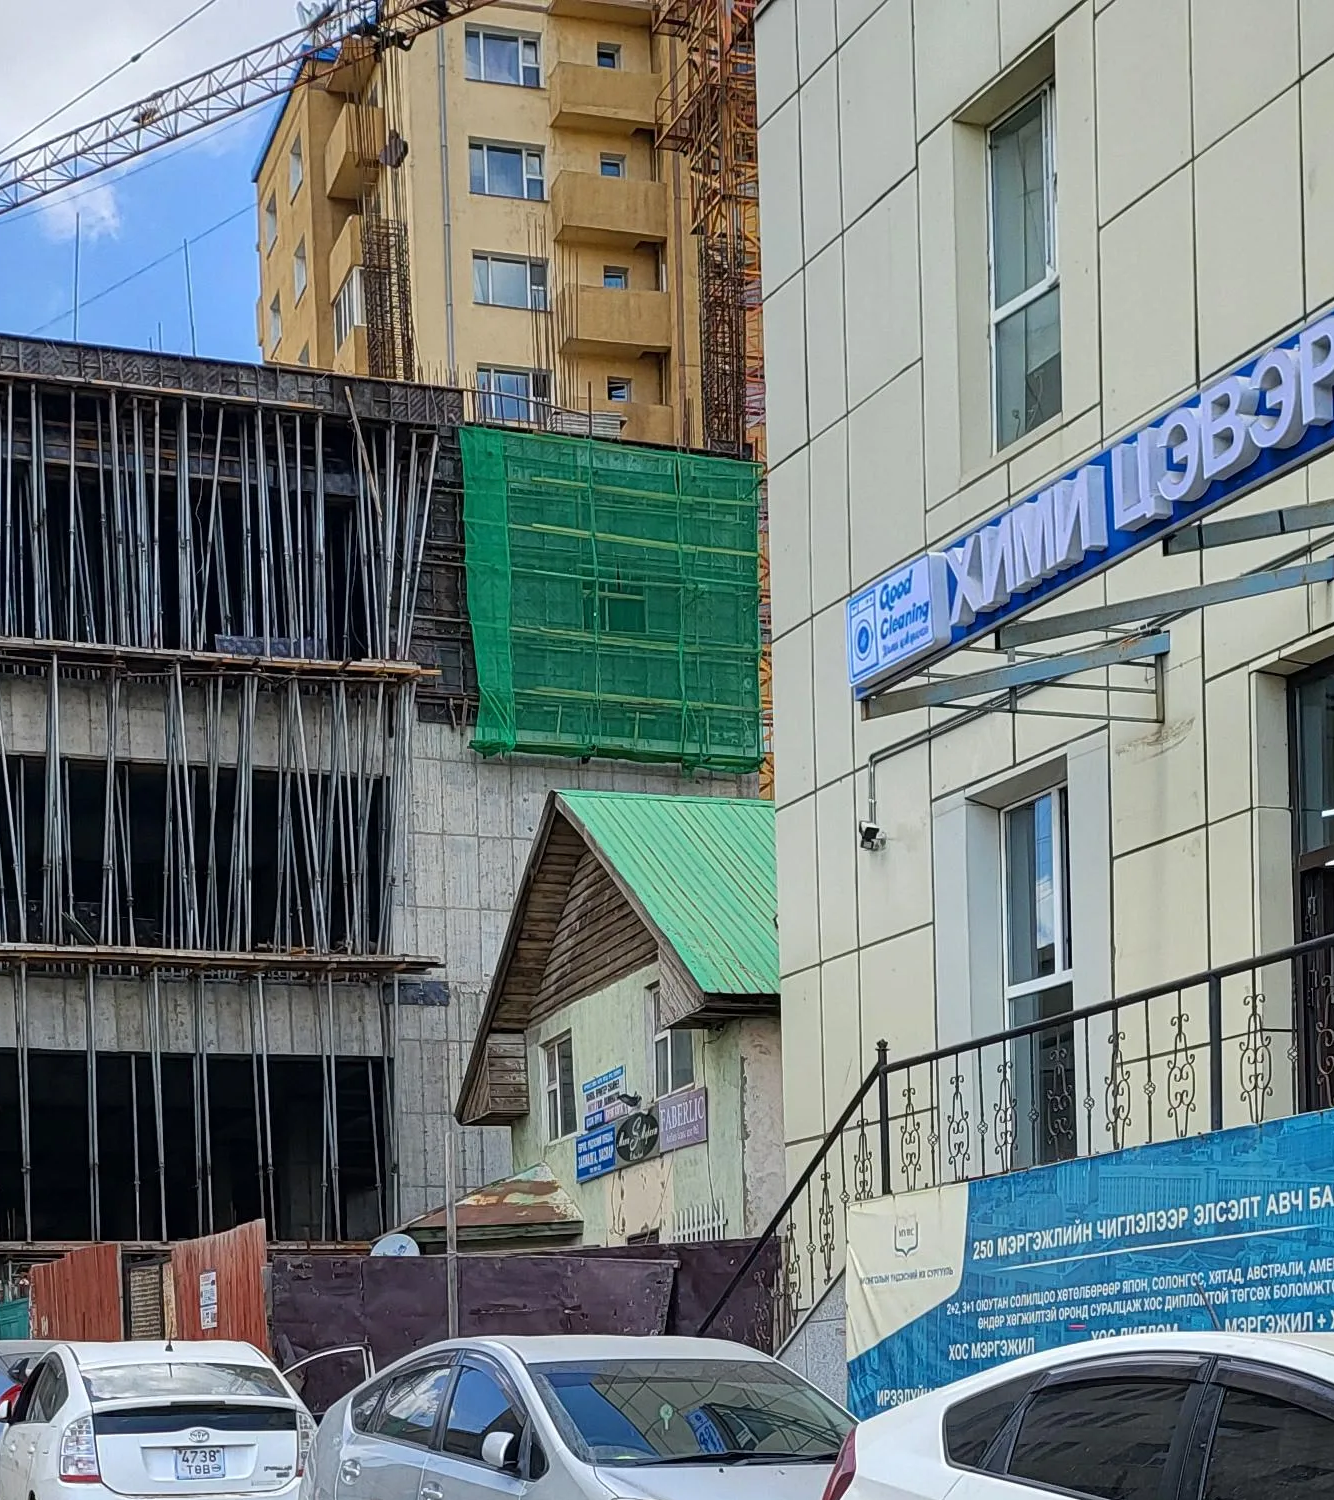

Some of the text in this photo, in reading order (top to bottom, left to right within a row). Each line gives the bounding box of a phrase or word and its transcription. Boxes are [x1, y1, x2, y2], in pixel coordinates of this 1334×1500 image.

[945, 464, 1108, 626] ХИМИ
[879, 568, 914, 612] Good
[880, 600, 930, 640] Cleaning
[972, 1238, 994, 1260] 250
[997, 1218, 1093, 1257] МЭРГЭЖЛИЙН
[1096, 1207, 1189, 1237] ЧИГЛЭЛЭЭР
[1194, 1195, 1262, 1226] ЭЛСЭЛТ
[1266, 1190, 1303, 1217] АВЧ
[946, 1302, 961, 1317] 2+2,
[961, 1300, 975, 1314] 3+1
[976, 1296, 1009, 1313] ОЮУТАН
[1010, 1290, 1056, 1310] СОЛИЛЦОО
[1057, 1281, 1121, 1302] ХӨТӨЛБӨРӨӨР
[1122, 1277, 1151, 1296] ЯПОН,
[1152, 1270, 1207, 1292] СОЛОНГОС,
[1208, 1267, 1245, 1286] ХЯТАД,
[1247, 1260, 1307, 1282] АВСТРАЛИ,
[977, 1313, 1005, 1331] ӨНДӨР
[1006, 1303, 1057, 1327] ХӨГЖИЛТЭЙ
[1058, 1304, 1089, 1322] ОРОНД
[1090, 1298, 1142, 1317] СУРАЛЦАЖ
[1143, 1297, 1163, 1310] ХОС
[1230, 1286, 1272, 1304] ТӨГСӨХ
[1224, 1311, 1314, 1333] МЭРГЭЖИЛ
[948, 1336, 1035, 1361] ХОС МЭРГЭЖИЛ
[181, 1450, 217, 1463] 4738
